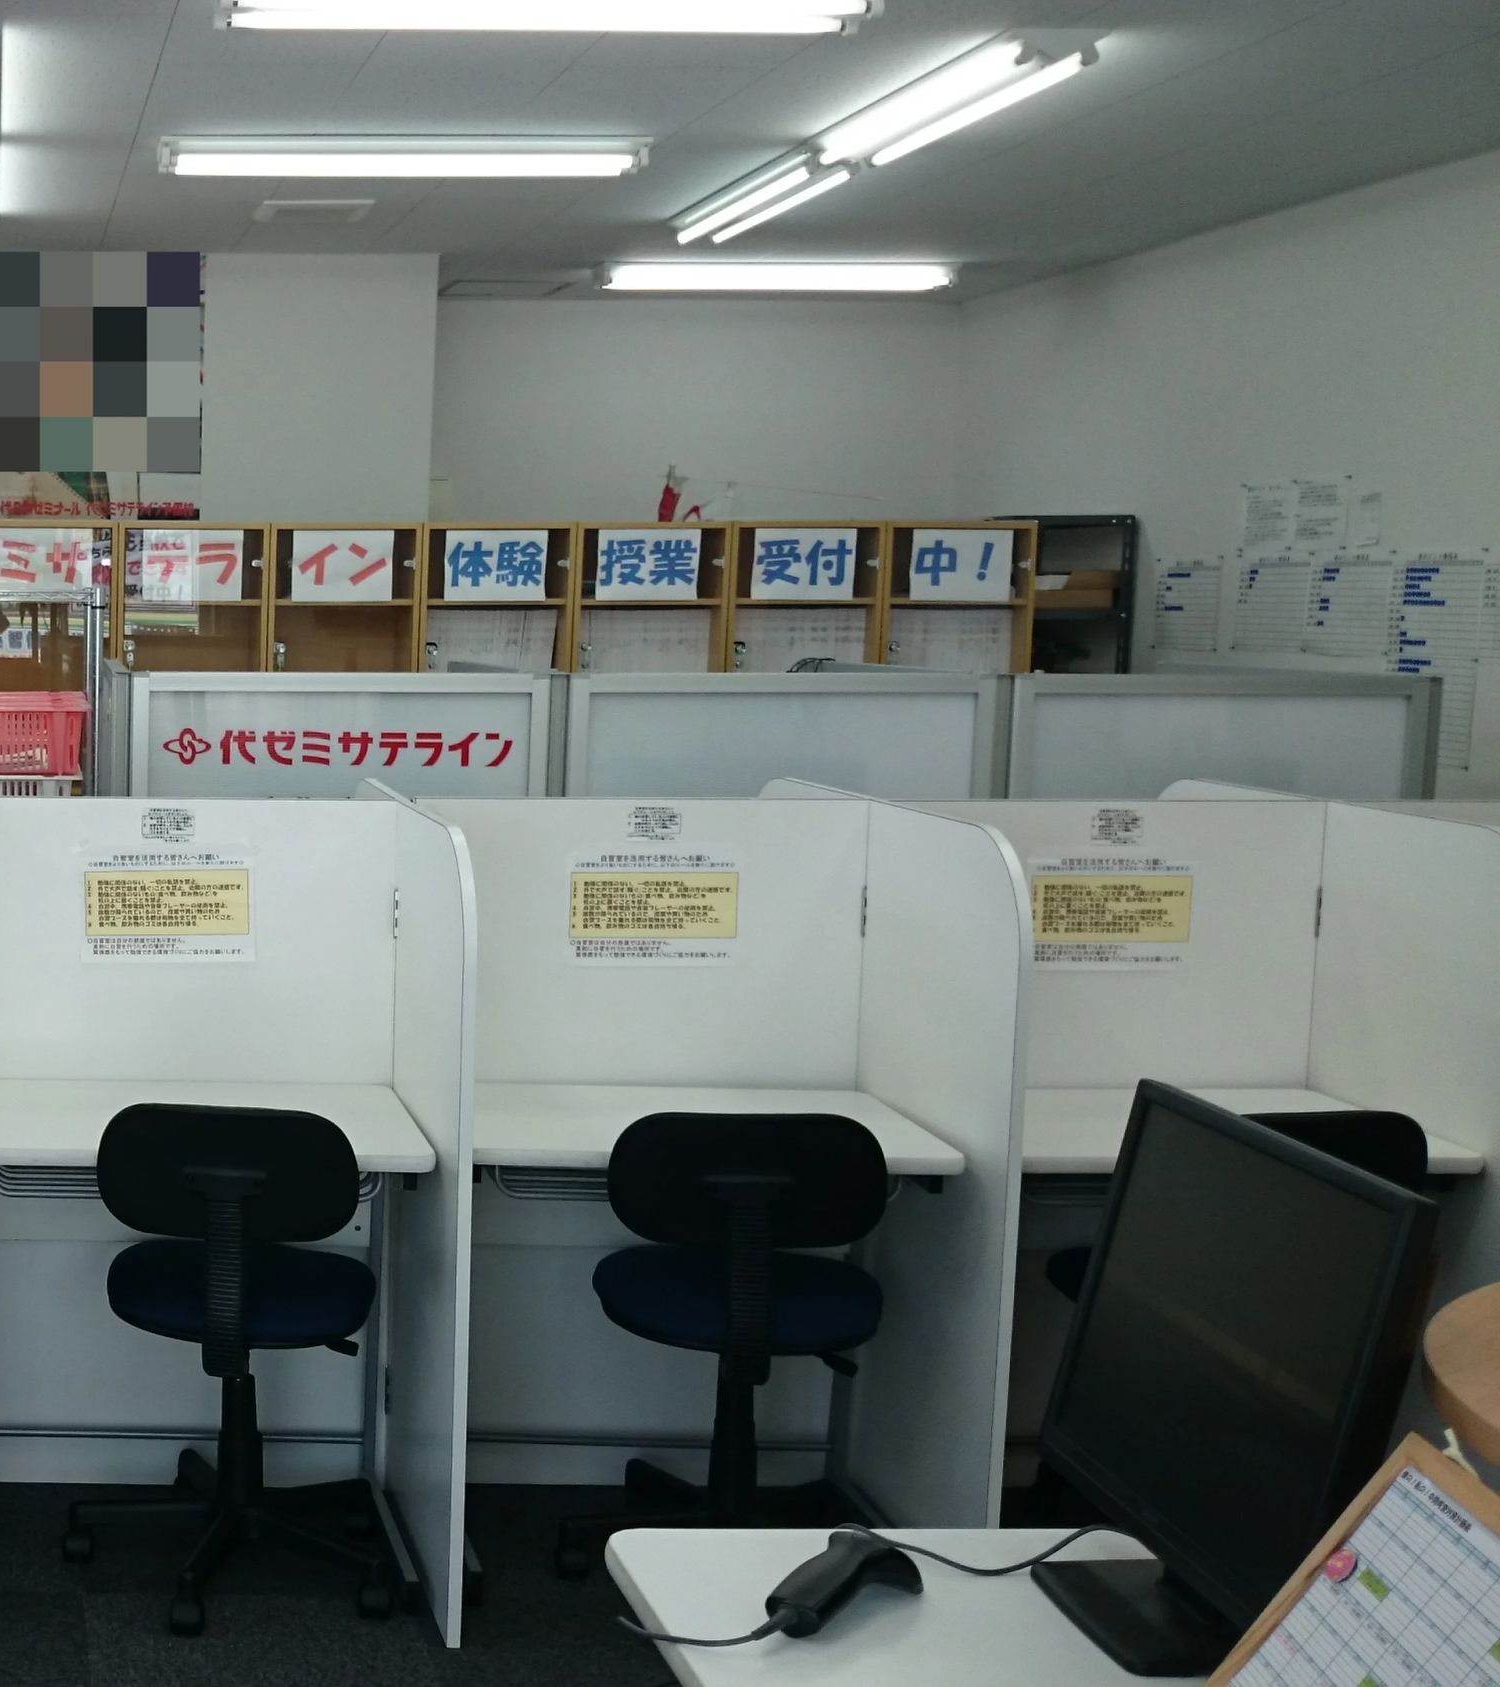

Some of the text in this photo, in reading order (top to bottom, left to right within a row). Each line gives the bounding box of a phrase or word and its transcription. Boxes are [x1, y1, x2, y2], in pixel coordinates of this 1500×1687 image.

[448, 541, 544, 587] 体験
[599, 539, 698, 586] 授業
[756, 539, 853, 586] 受付
[220, 729, 513, 767] 代ゼミサテライン
